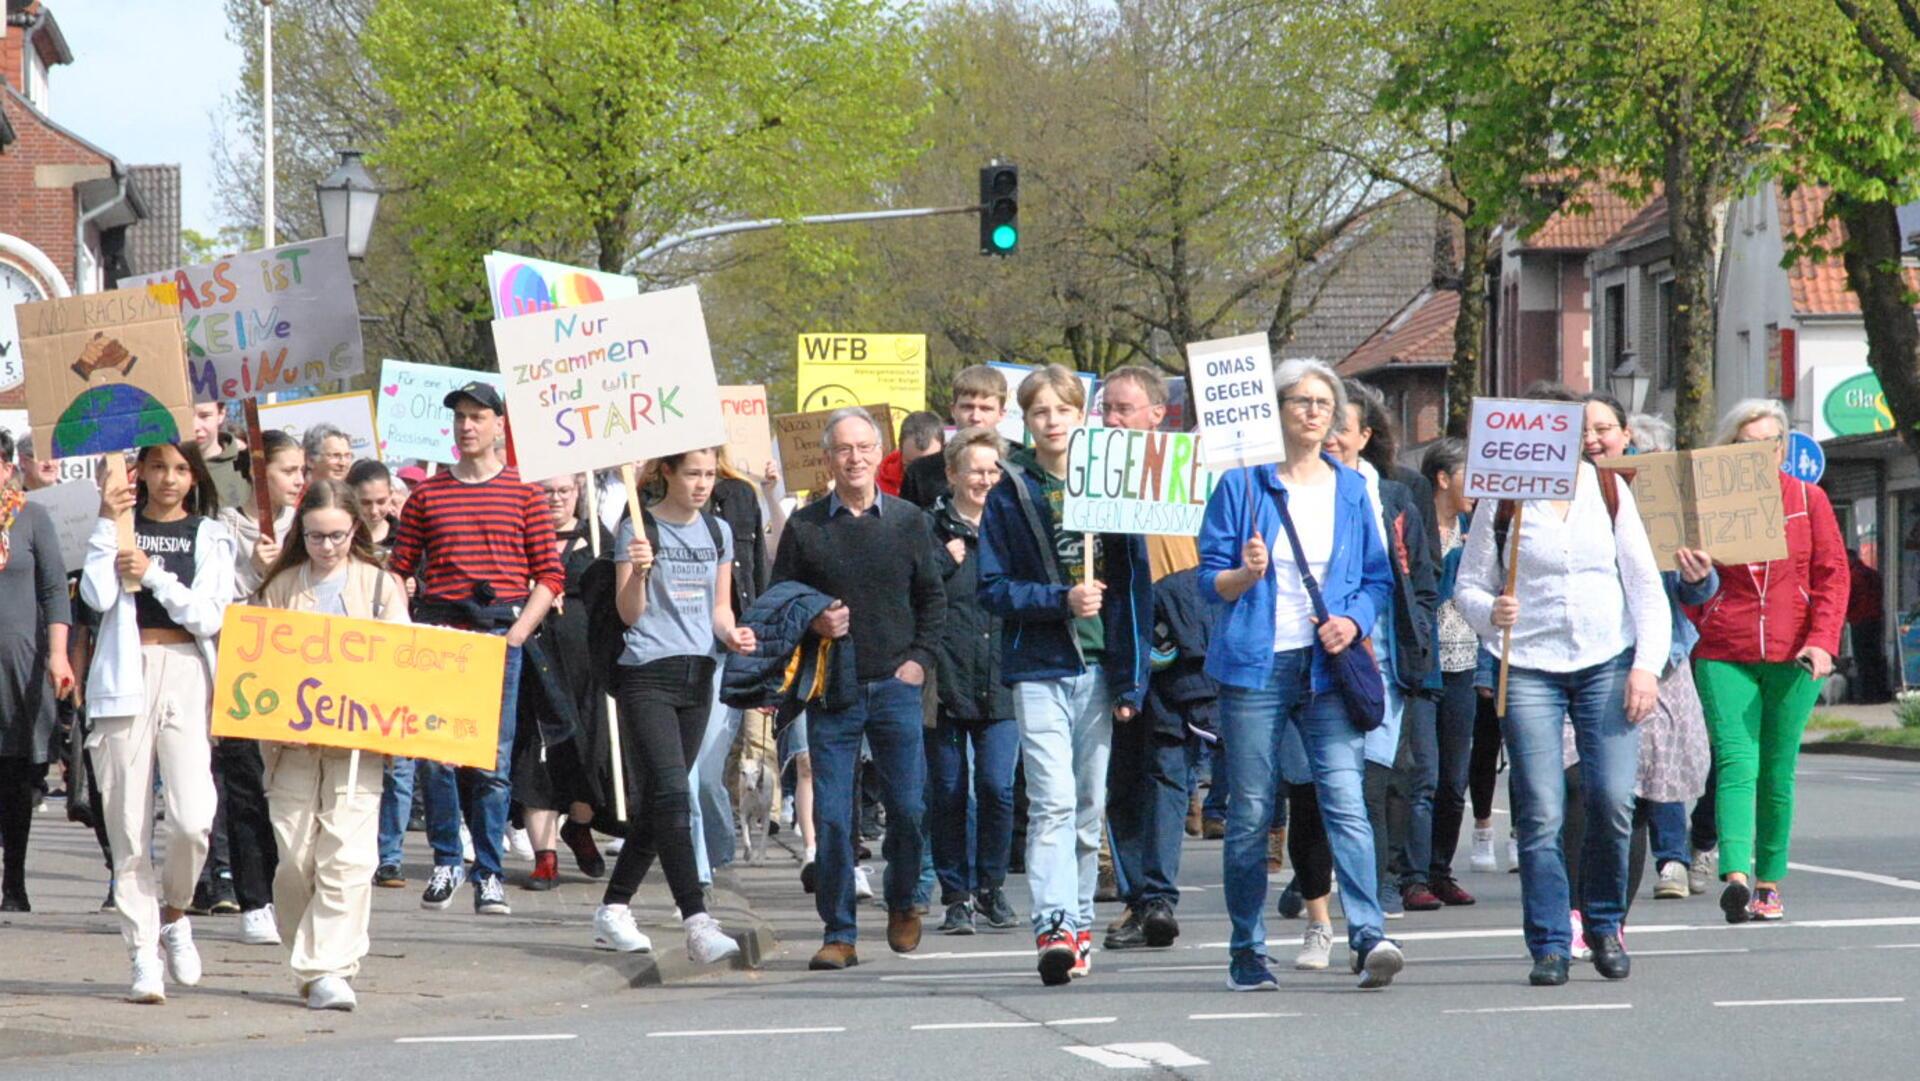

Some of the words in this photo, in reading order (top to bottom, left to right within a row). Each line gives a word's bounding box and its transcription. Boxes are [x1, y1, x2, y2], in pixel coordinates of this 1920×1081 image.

[36, 301, 70, 338] NO
[83, 293, 162, 326] RACISM
[554, 314, 609, 343] Nur
[513, 336, 649, 385] zusammen
[804, 336, 868, 361] WFB
[1206, 355, 1256, 377] OMAS
[539, 378, 583, 407] sind
[602, 371, 641, 393] wir
[1205, 379, 1264, 402] GEGEN
[555, 385, 684, 447] STARK
[720, 398, 766, 416] rven
[1203, 402, 1272, 427] RECHTS
[1486, 412, 1569, 432] OMA'S
[1481, 441, 1566, 462] GEGEN
[1470, 473, 1570, 495] RECHTS
[1071, 500, 1124, 530] GEGEN
[237, 614, 386, 664] Jeder
[227, 671, 280, 720] So
[289, 677, 369, 731] Sein
[424, 713, 448, 731] er
